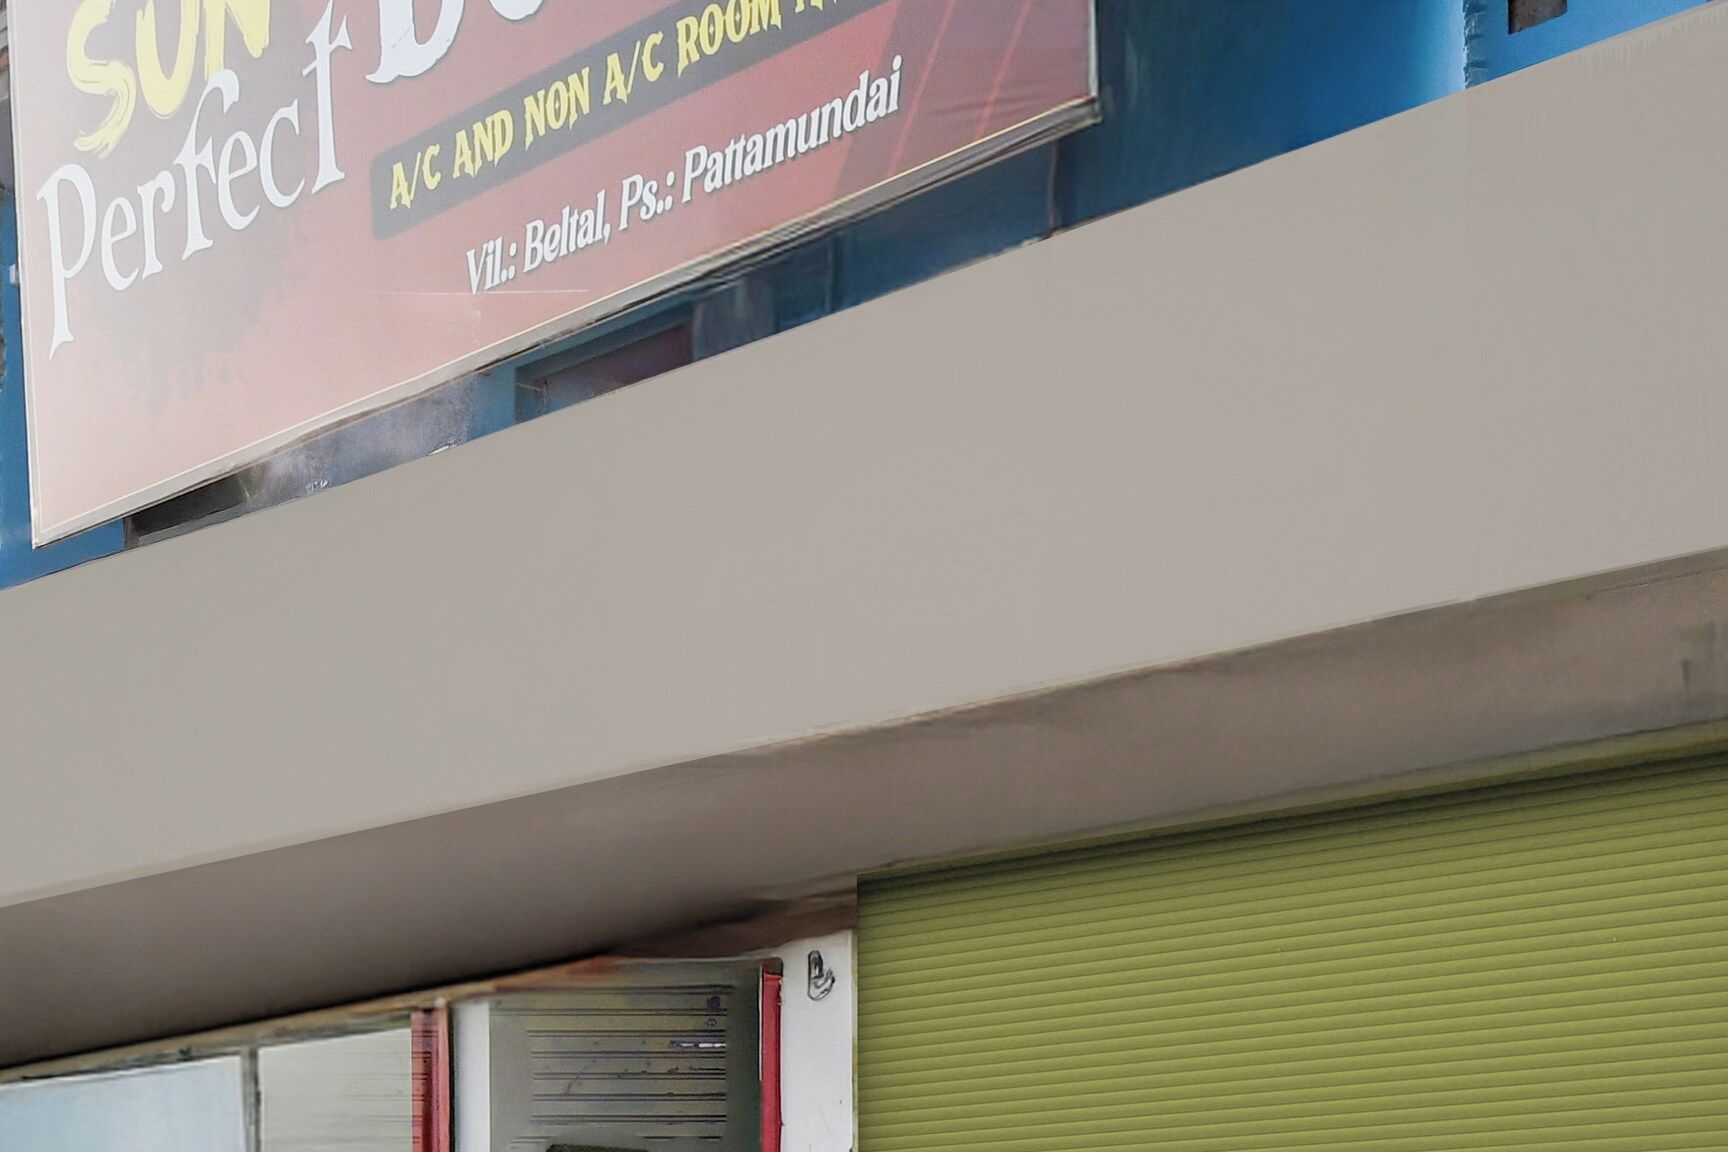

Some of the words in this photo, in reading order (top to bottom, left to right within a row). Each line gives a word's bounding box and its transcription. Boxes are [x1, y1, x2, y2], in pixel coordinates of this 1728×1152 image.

[37, 0, 352, 360] Perfect
[390, 143, 442, 210] A/C
[452, 109, 514, 179] AND
[523, 66, 590, 150] NON
[602, 31, 664, 105] A/C
[676, 0, 782, 78] ROOM
[522, 188, 611, 273] Beltal,
[618, 170, 685, 231] Ps.:
[681, 54, 903, 204] Pattamundai
